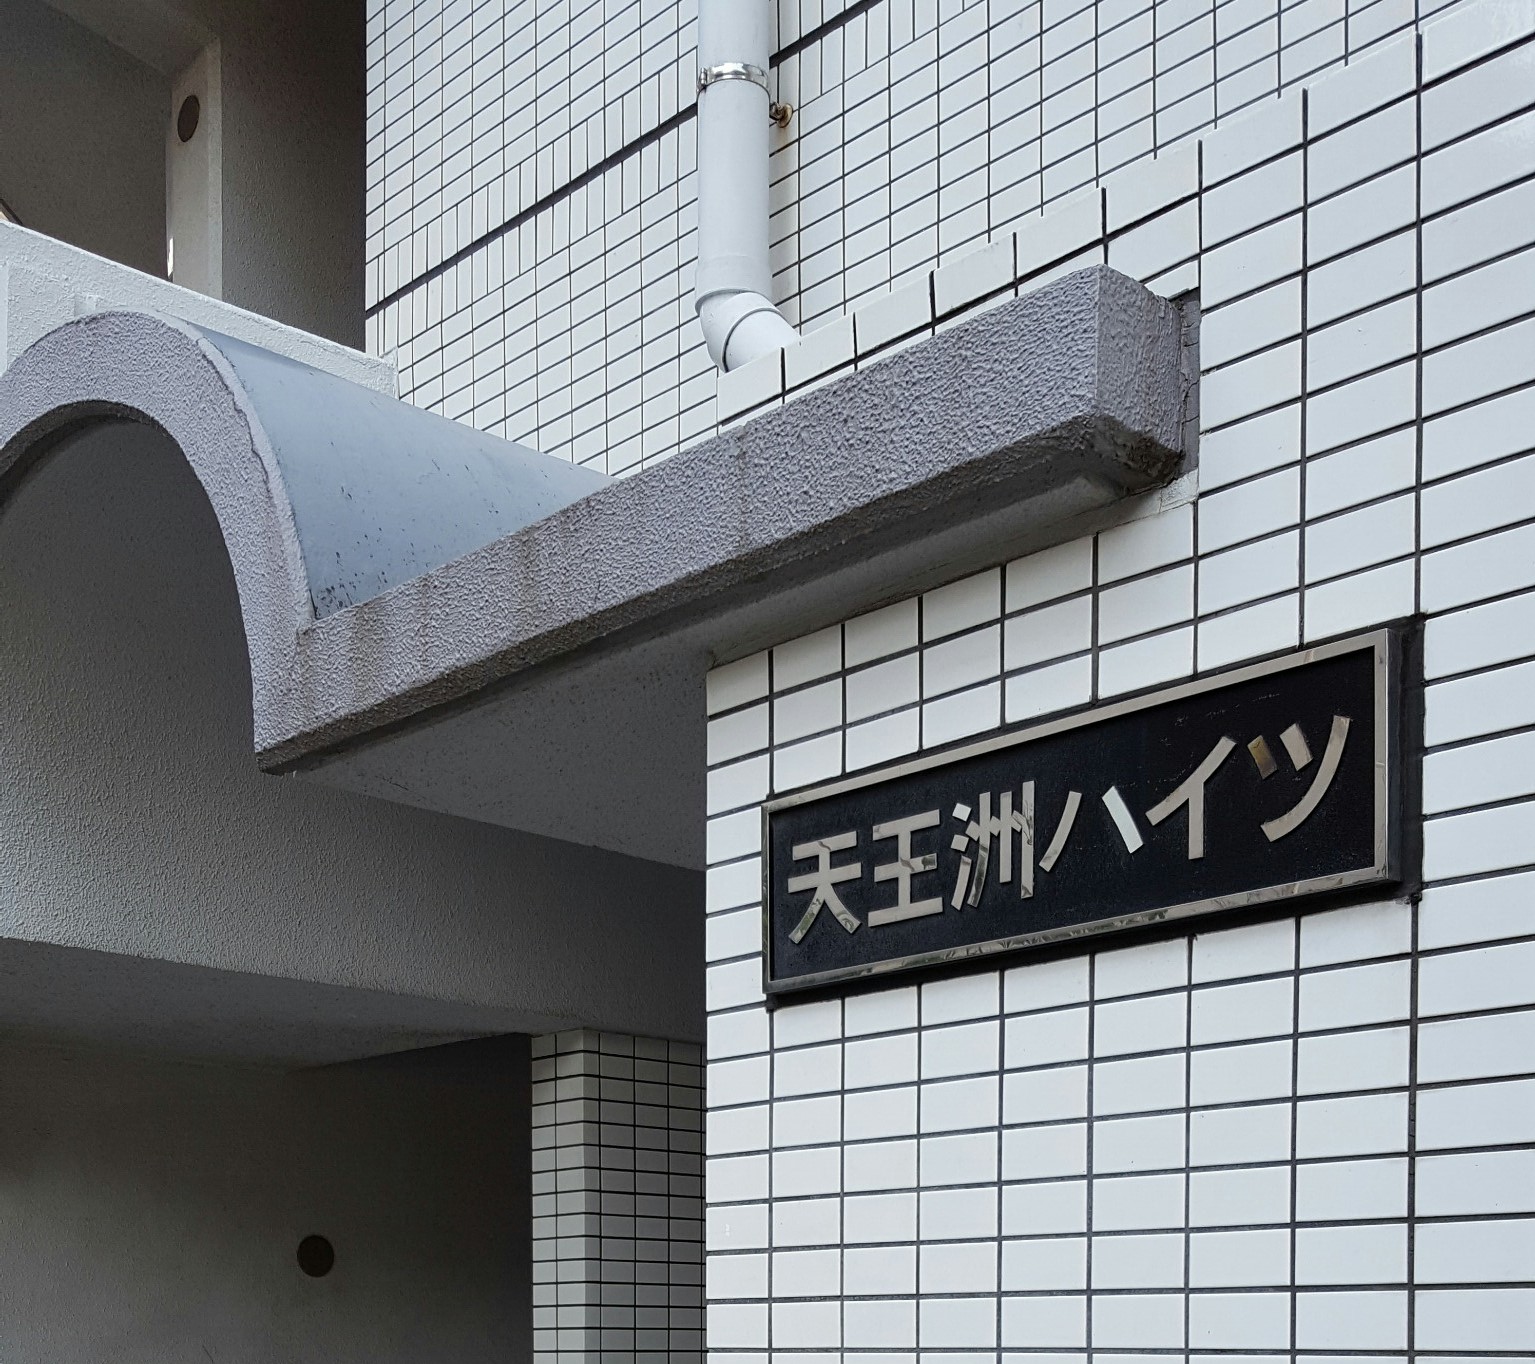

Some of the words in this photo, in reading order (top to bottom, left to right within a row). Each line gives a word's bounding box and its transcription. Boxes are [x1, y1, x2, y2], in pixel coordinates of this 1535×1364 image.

[788, 714, 1350, 944] 天王洲ハイツ
